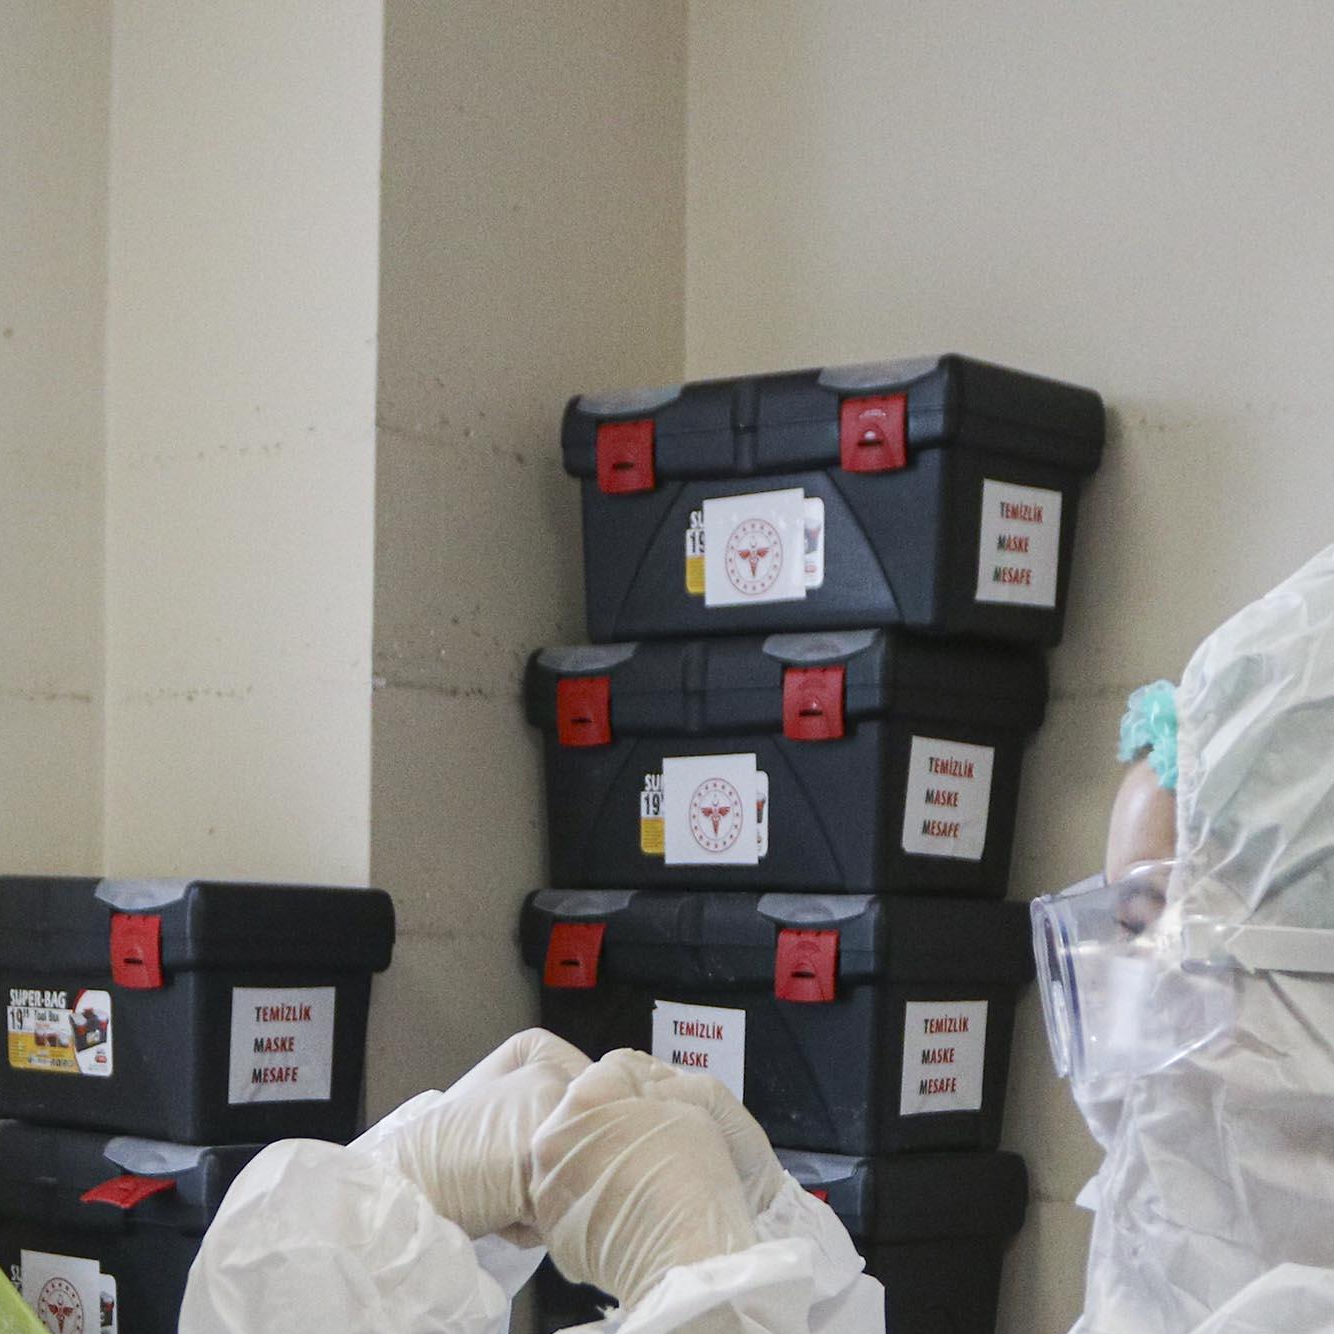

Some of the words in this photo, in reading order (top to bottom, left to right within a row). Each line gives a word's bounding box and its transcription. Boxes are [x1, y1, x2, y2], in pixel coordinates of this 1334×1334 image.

[997, 534, 1031, 553] MASKE
[992, 565, 1033, 586] MESAFE
[929, 756, 975, 779] TEMİZLİK
[925, 787, 960, 808] MASKE
[921, 819, 961, 839] MESAFE
[9, 988, 68, 1009] SUPER-BAG
[254, 1002, 312, 1022] TEMİZLİK
[673, 1019, 724, 1041] TEMİZLİK
[923, 1013, 969, 1034] TEMİZLİK
[253, 1036, 295, 1054] MASKE
[672, 1049, 709, 1069] MASKE
[921, 1047, 956, 1065] MASKE
[251, 1066, 299, 1084] MESAFE
[918, 1077, 957, 1096] MESAFE
